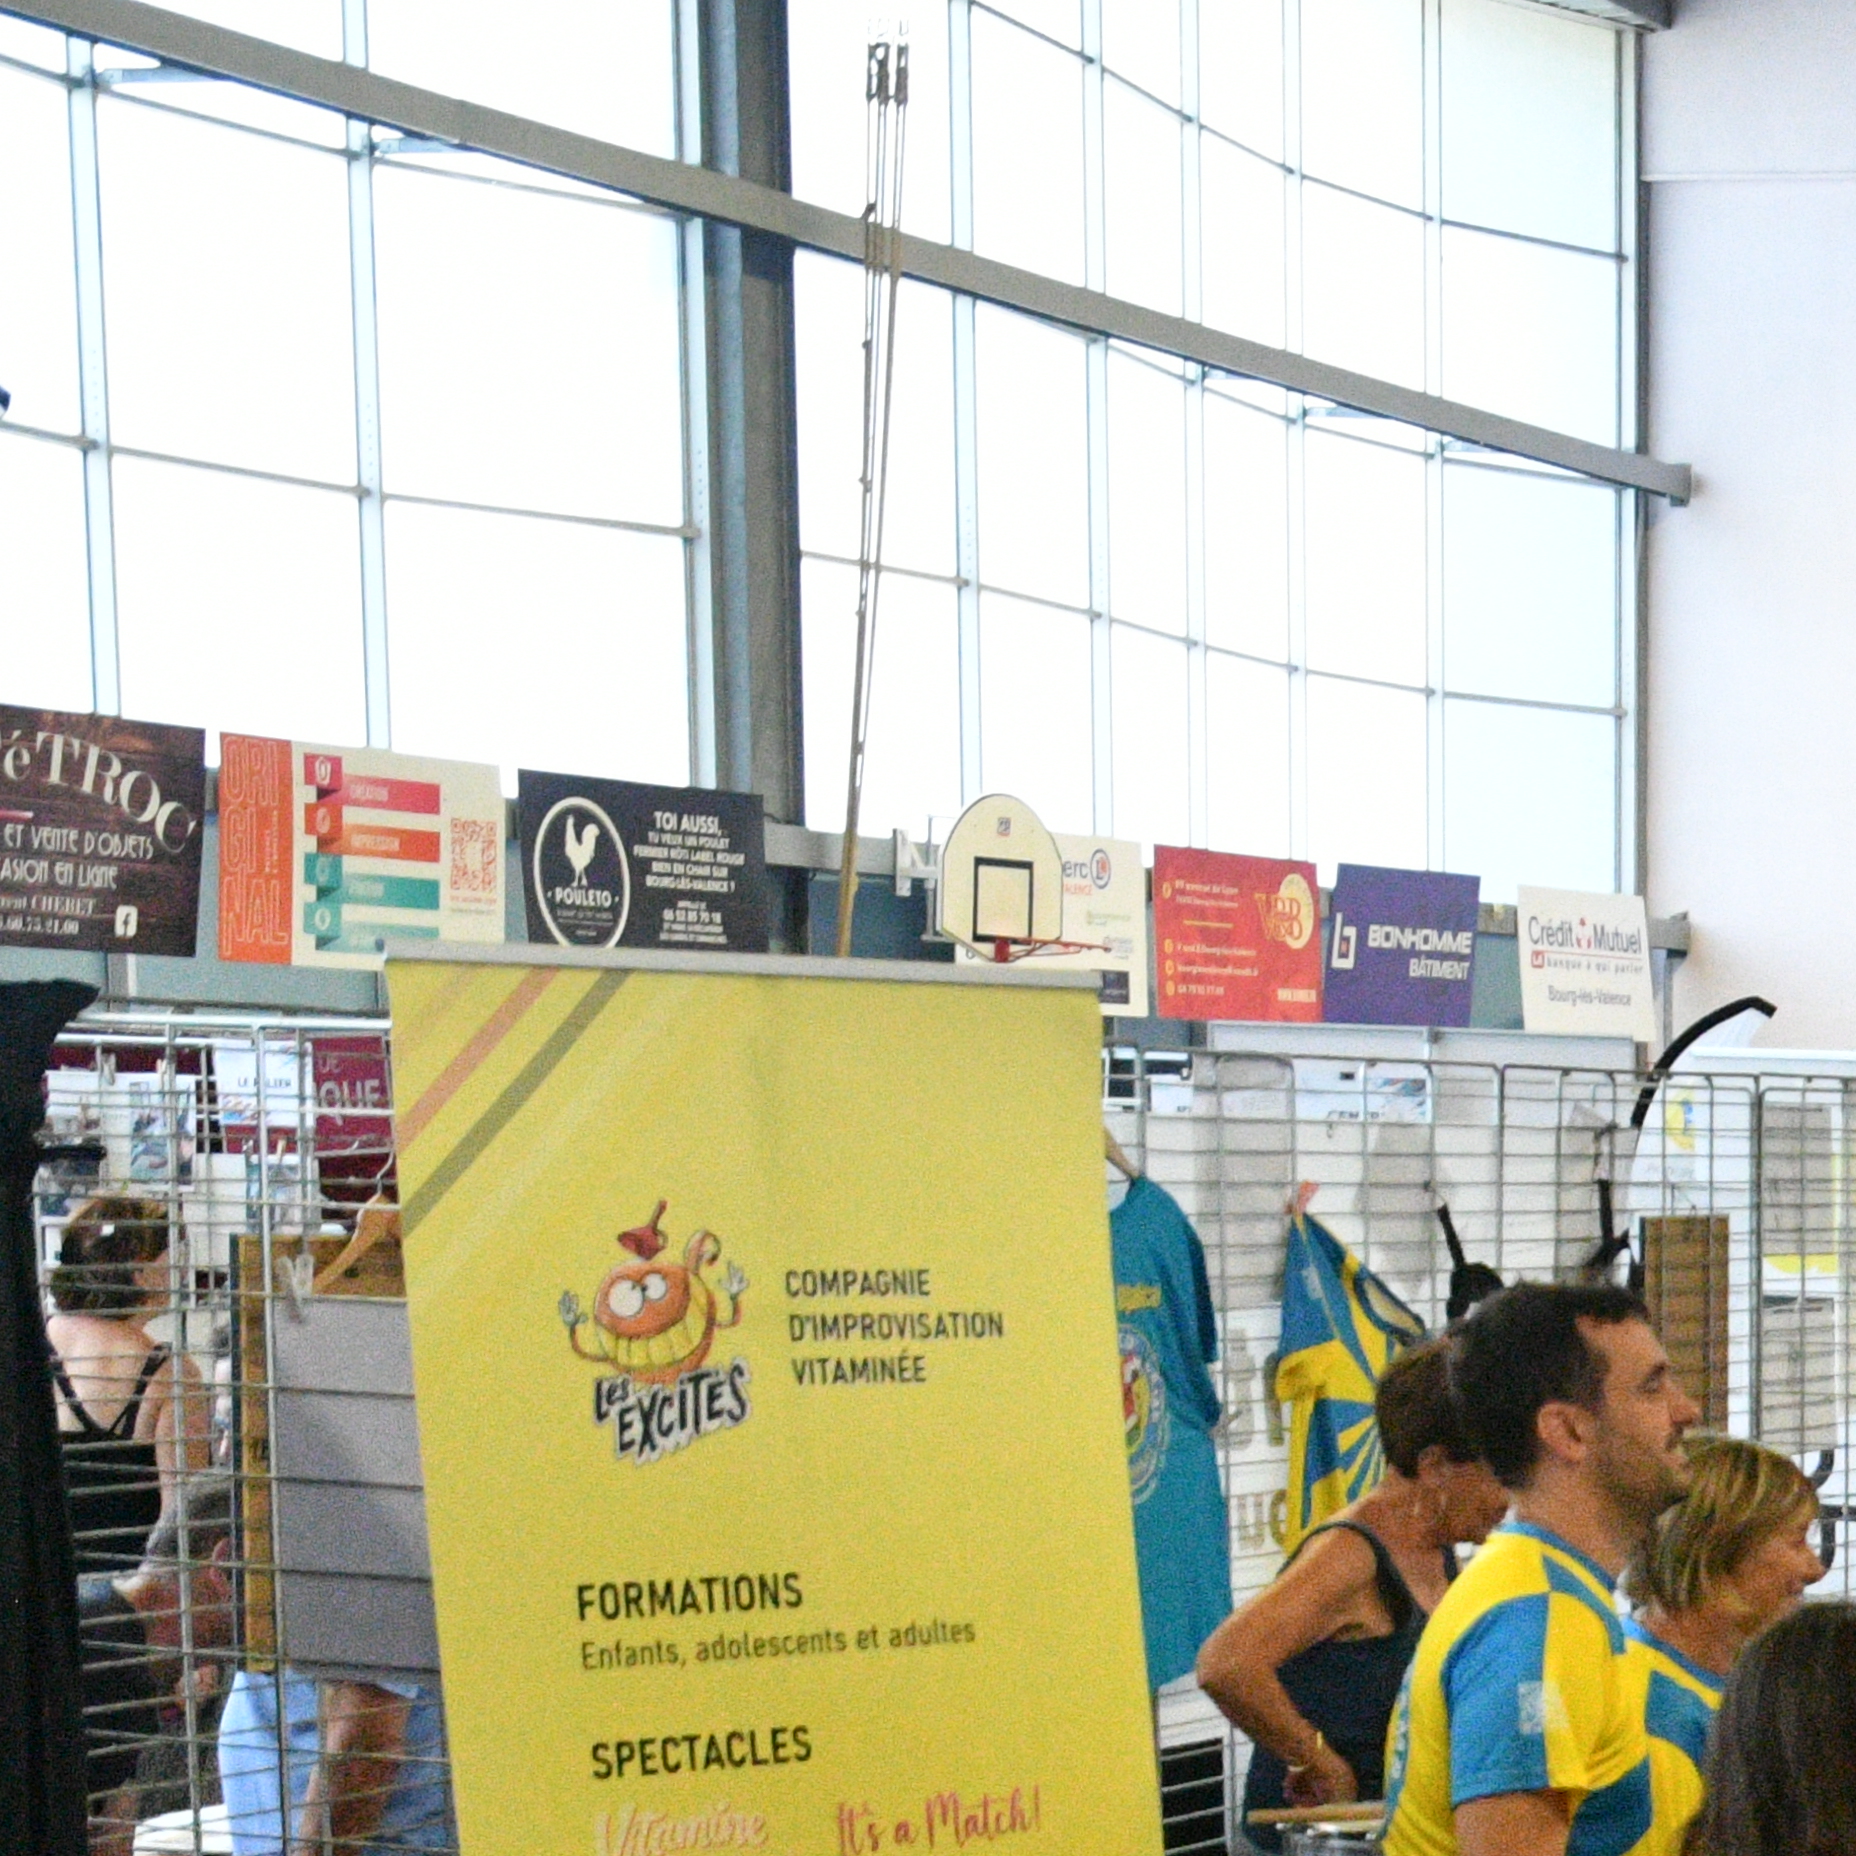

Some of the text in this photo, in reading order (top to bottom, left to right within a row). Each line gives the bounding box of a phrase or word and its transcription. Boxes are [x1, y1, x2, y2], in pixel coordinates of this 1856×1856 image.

[653, 811, 722, 836] TOI AUSSI,
[31, 825, 79, 855] VENTE
[84, 831, 154, 860] D'OBJETS
[1367, 923, 1473, 955] BONHOMME
[1528, 916, 1643, 954] Crédit Mutuel
[1409, 953, 1471, 980] BÂTIMENT
[785, 1268, 932, 1298] COMPAGNIE
[789, 1311, 1005, 1342] D'IMPROVISATION
[791, 1349, 927, 1387] VITAMINÉE
[577, 1572, 803, 1622] FORMATIONS
[581, 1617, 976, 1670] Enfants, adolescents et adultes
[591, 1726, 813, 1780] SPECTACLES
[893, 1823, 918, 1848] a
[923, 1784, 1041, 1850] Match!
